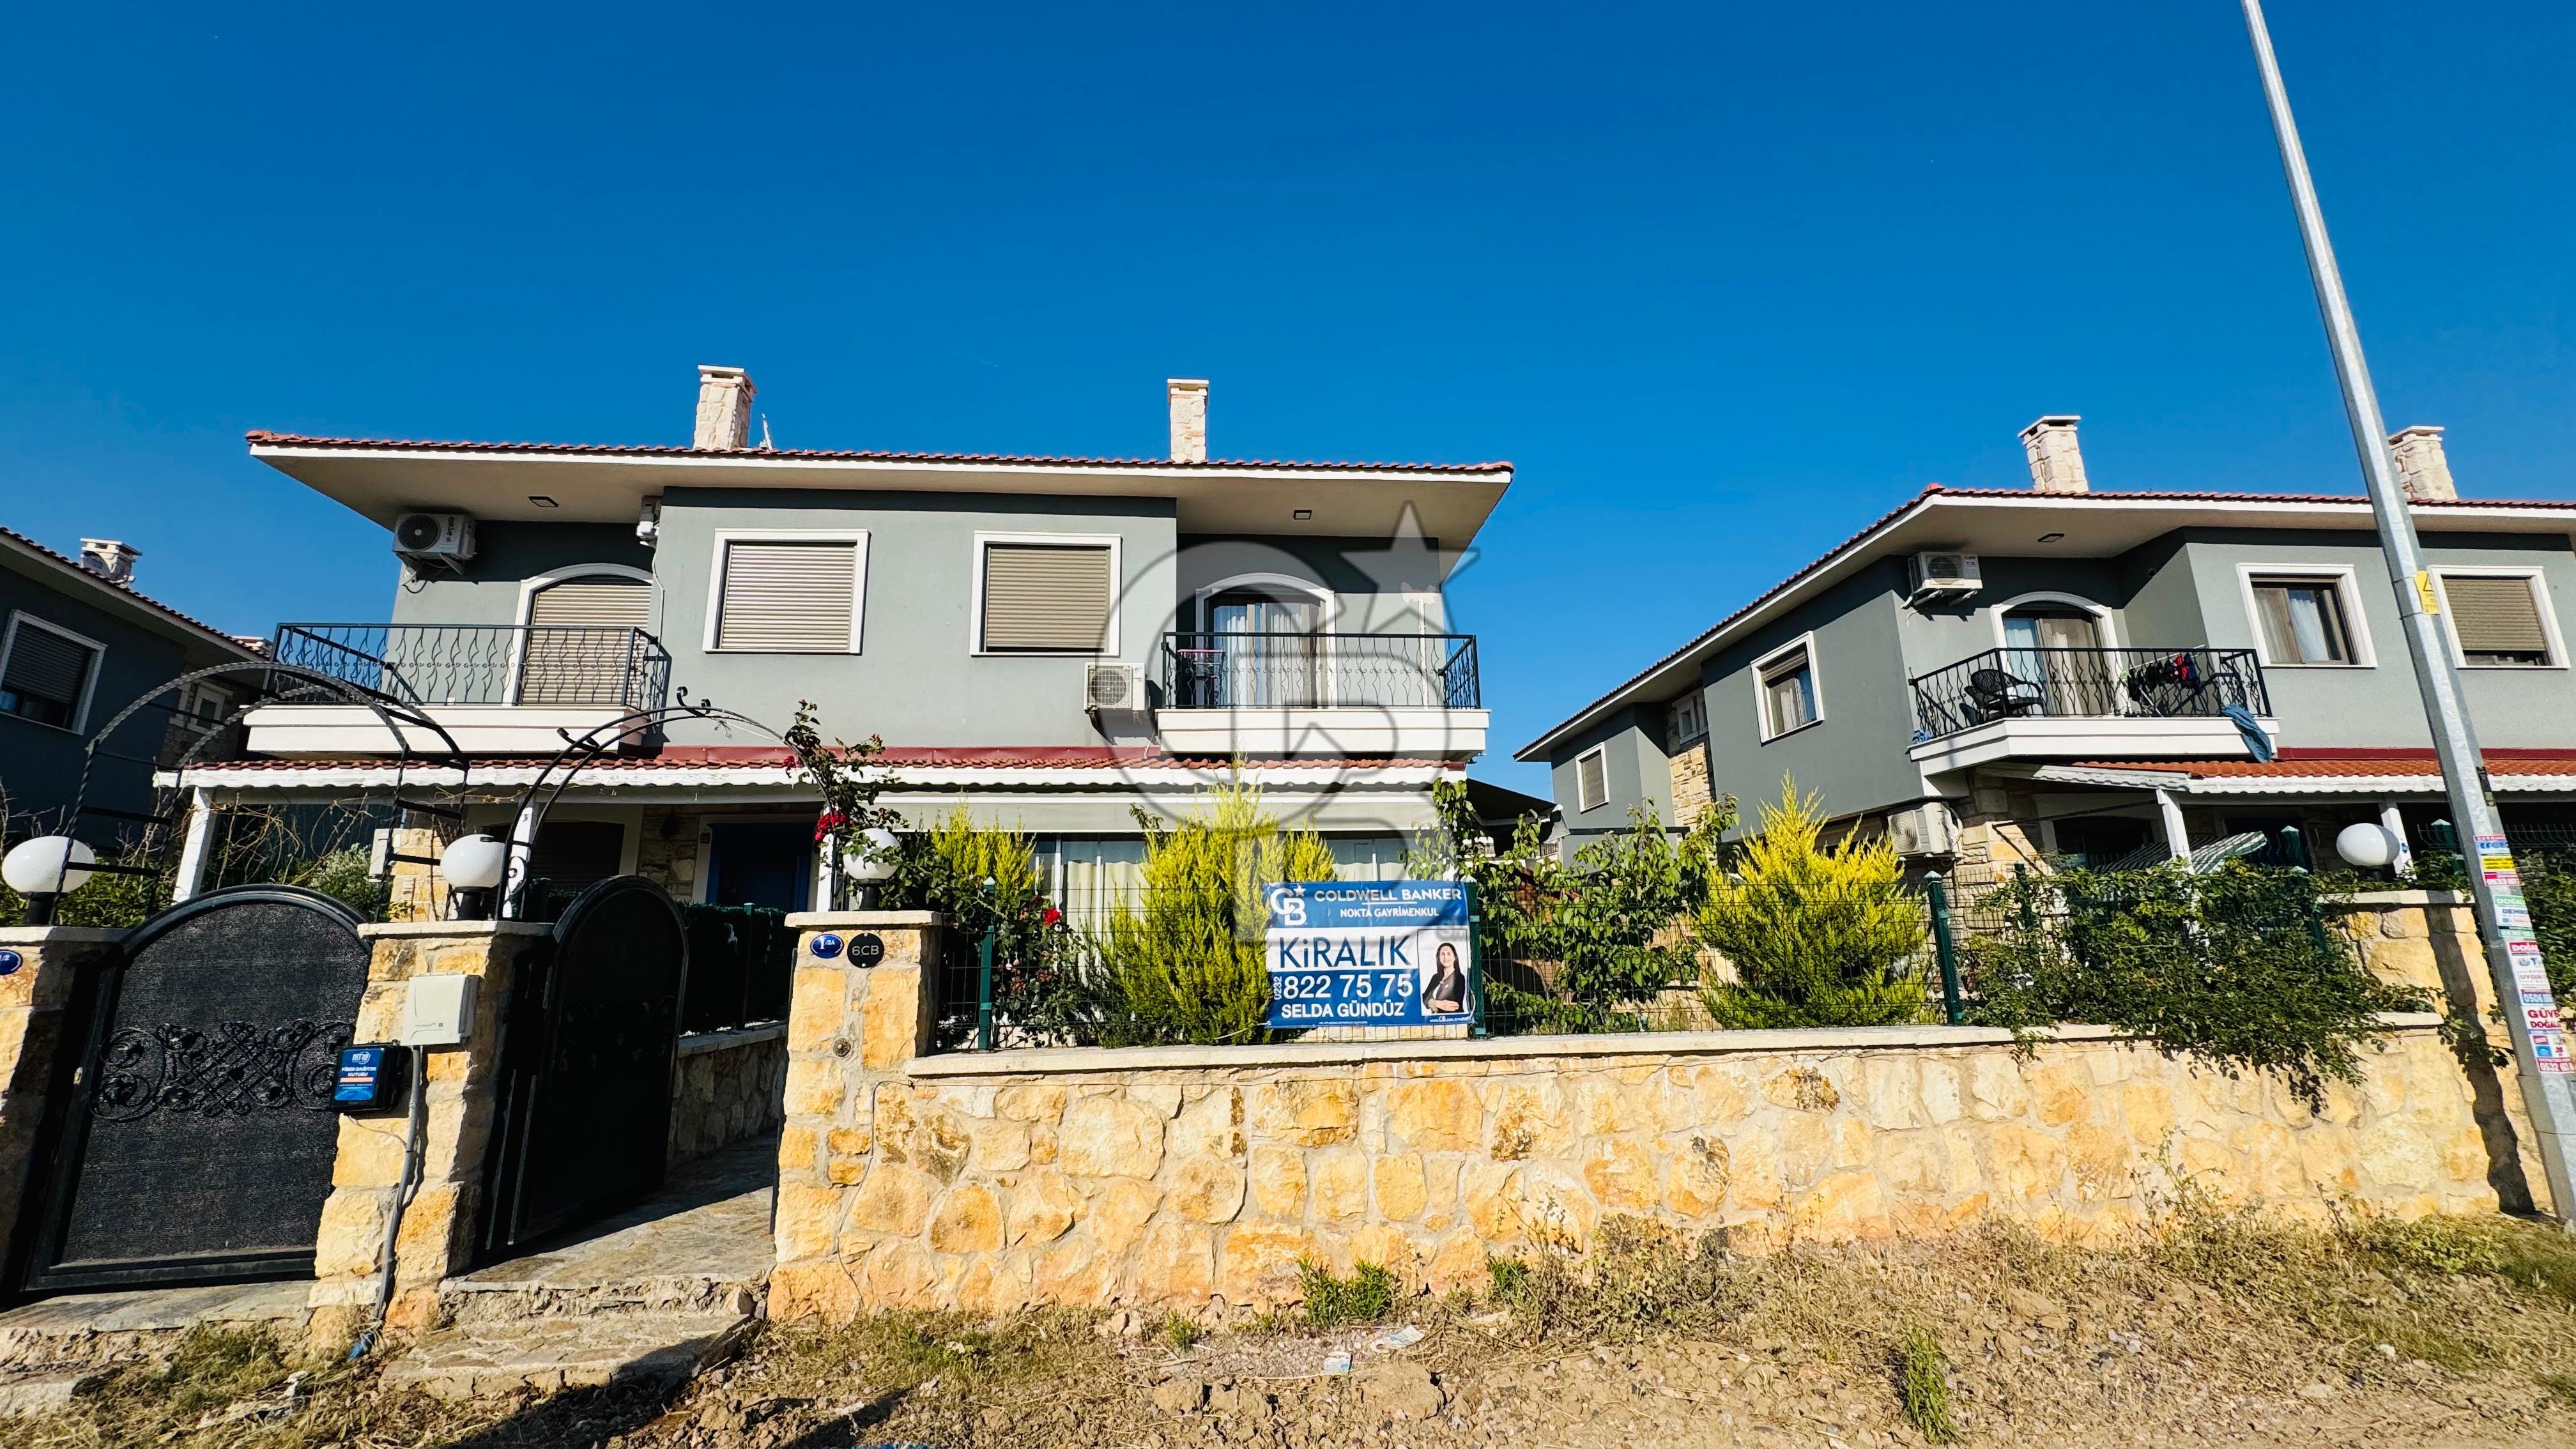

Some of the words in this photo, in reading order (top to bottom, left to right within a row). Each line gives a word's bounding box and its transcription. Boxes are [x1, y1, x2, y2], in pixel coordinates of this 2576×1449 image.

[1314, 889, 1398, 902] COLDWELL
[1401, 888, 1462, 901] BANKER
[1340, 907, 1373, 918] NOKTA
[1374, 905, 1440, 917] GAYRİMENKUL
[1272, 976, 1282, 1000] 0232
[1283, 974, 1331, 1000] 822
[1339, 973, 1372, 998] 75
[1380, 973, 1413, 997] 75
[1281, 1003, 1335, 1018] SELDA
[1337, 999, 1405, 1018] GÜNDÜZ
